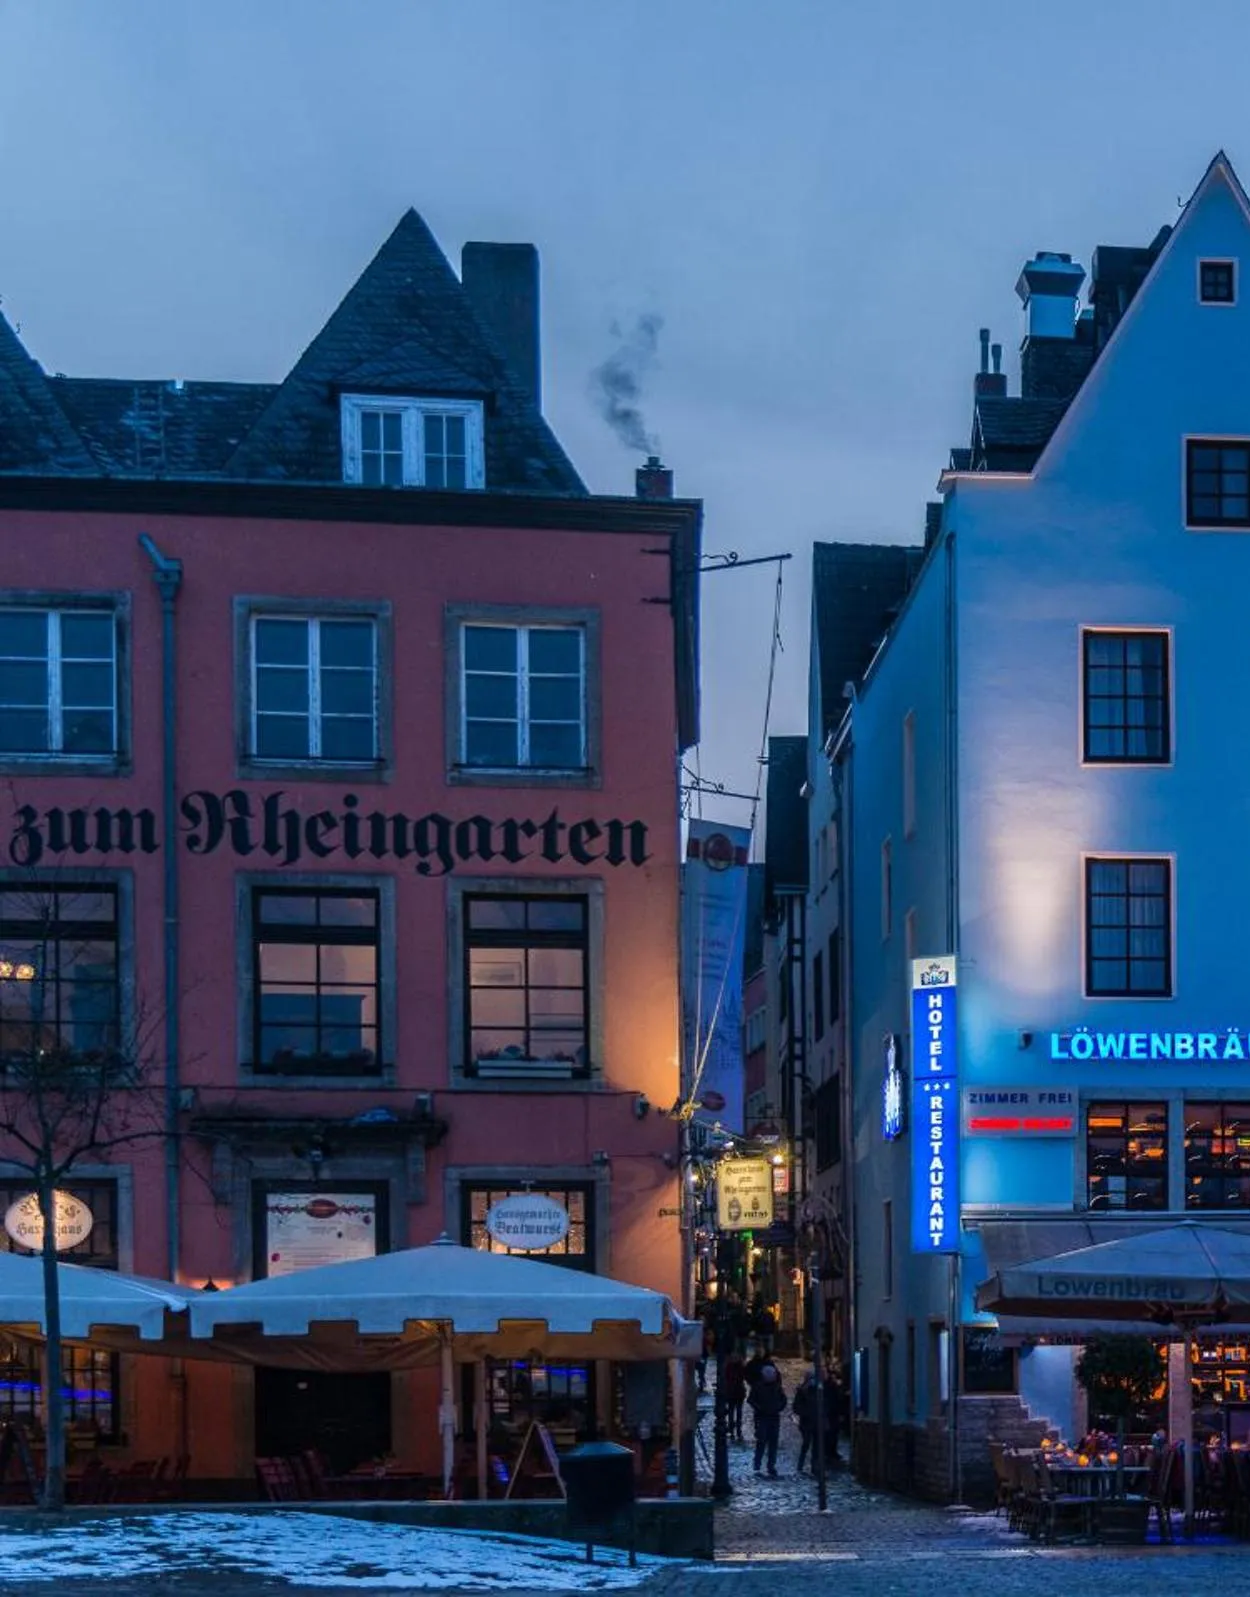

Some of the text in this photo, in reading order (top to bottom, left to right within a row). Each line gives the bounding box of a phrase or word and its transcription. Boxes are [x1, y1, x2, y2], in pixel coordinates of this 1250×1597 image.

[9, 789, 653, 877] zum Rheingarten
[928, 994, 943, 1072] HOTEL
[969, 1092, 1072, 1104] ZIMMER FREI
[929, 1095, 944, 1247] RESTAURANT
